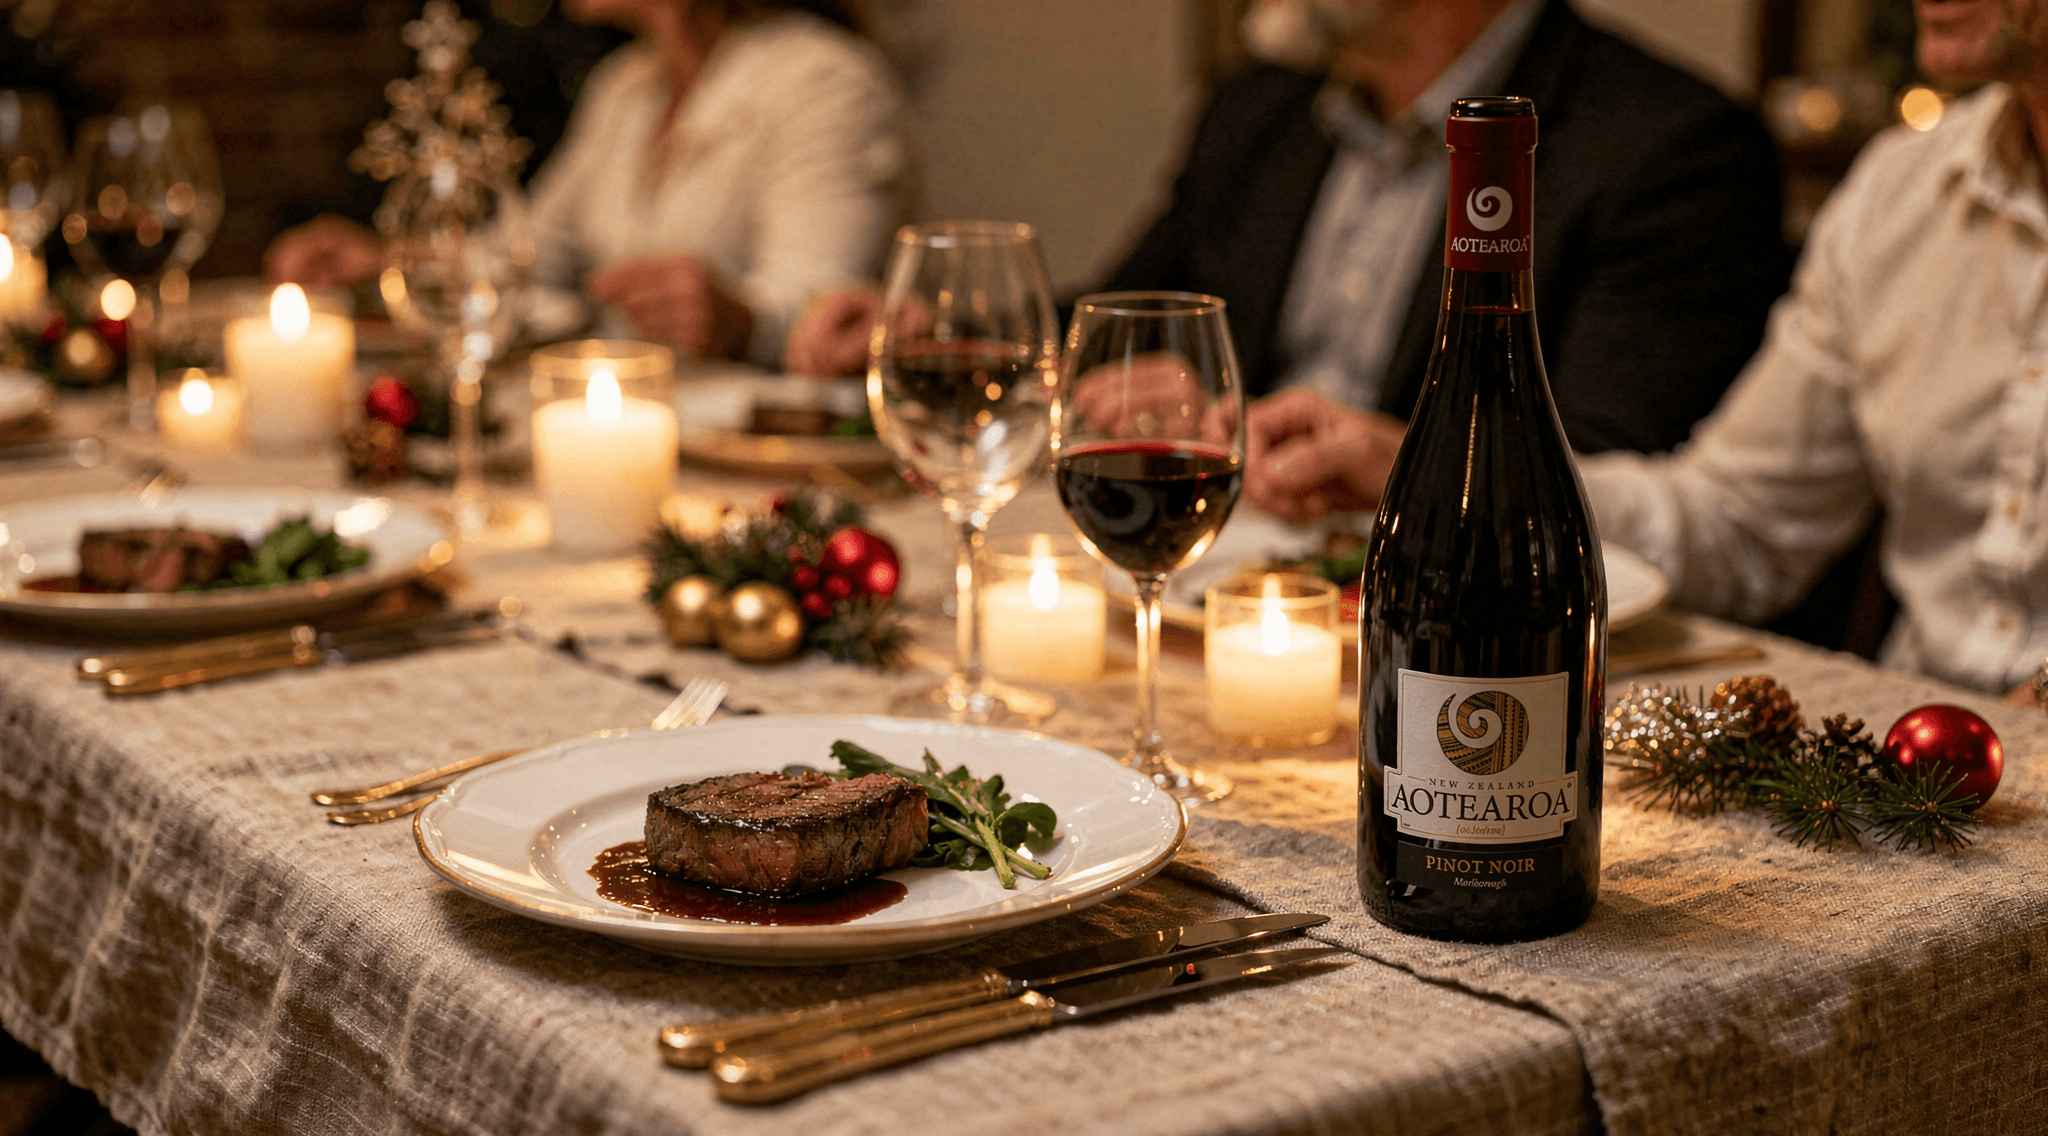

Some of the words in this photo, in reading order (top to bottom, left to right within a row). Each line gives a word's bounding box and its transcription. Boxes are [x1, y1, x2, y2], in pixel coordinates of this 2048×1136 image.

[1450, 236, 1528, 253] AOTEAROA
[1429, 777, 1459, 788] NEW
[1467, 780, 1535, 790] ZEALAND
[1391, 784, 1570, 821] AOTEAROA
[1425, 855, 1483, 874] PINOT
[1488, 858, 1535, 874] NOIR
[1453, 877, 1507, 890] Marlborough
